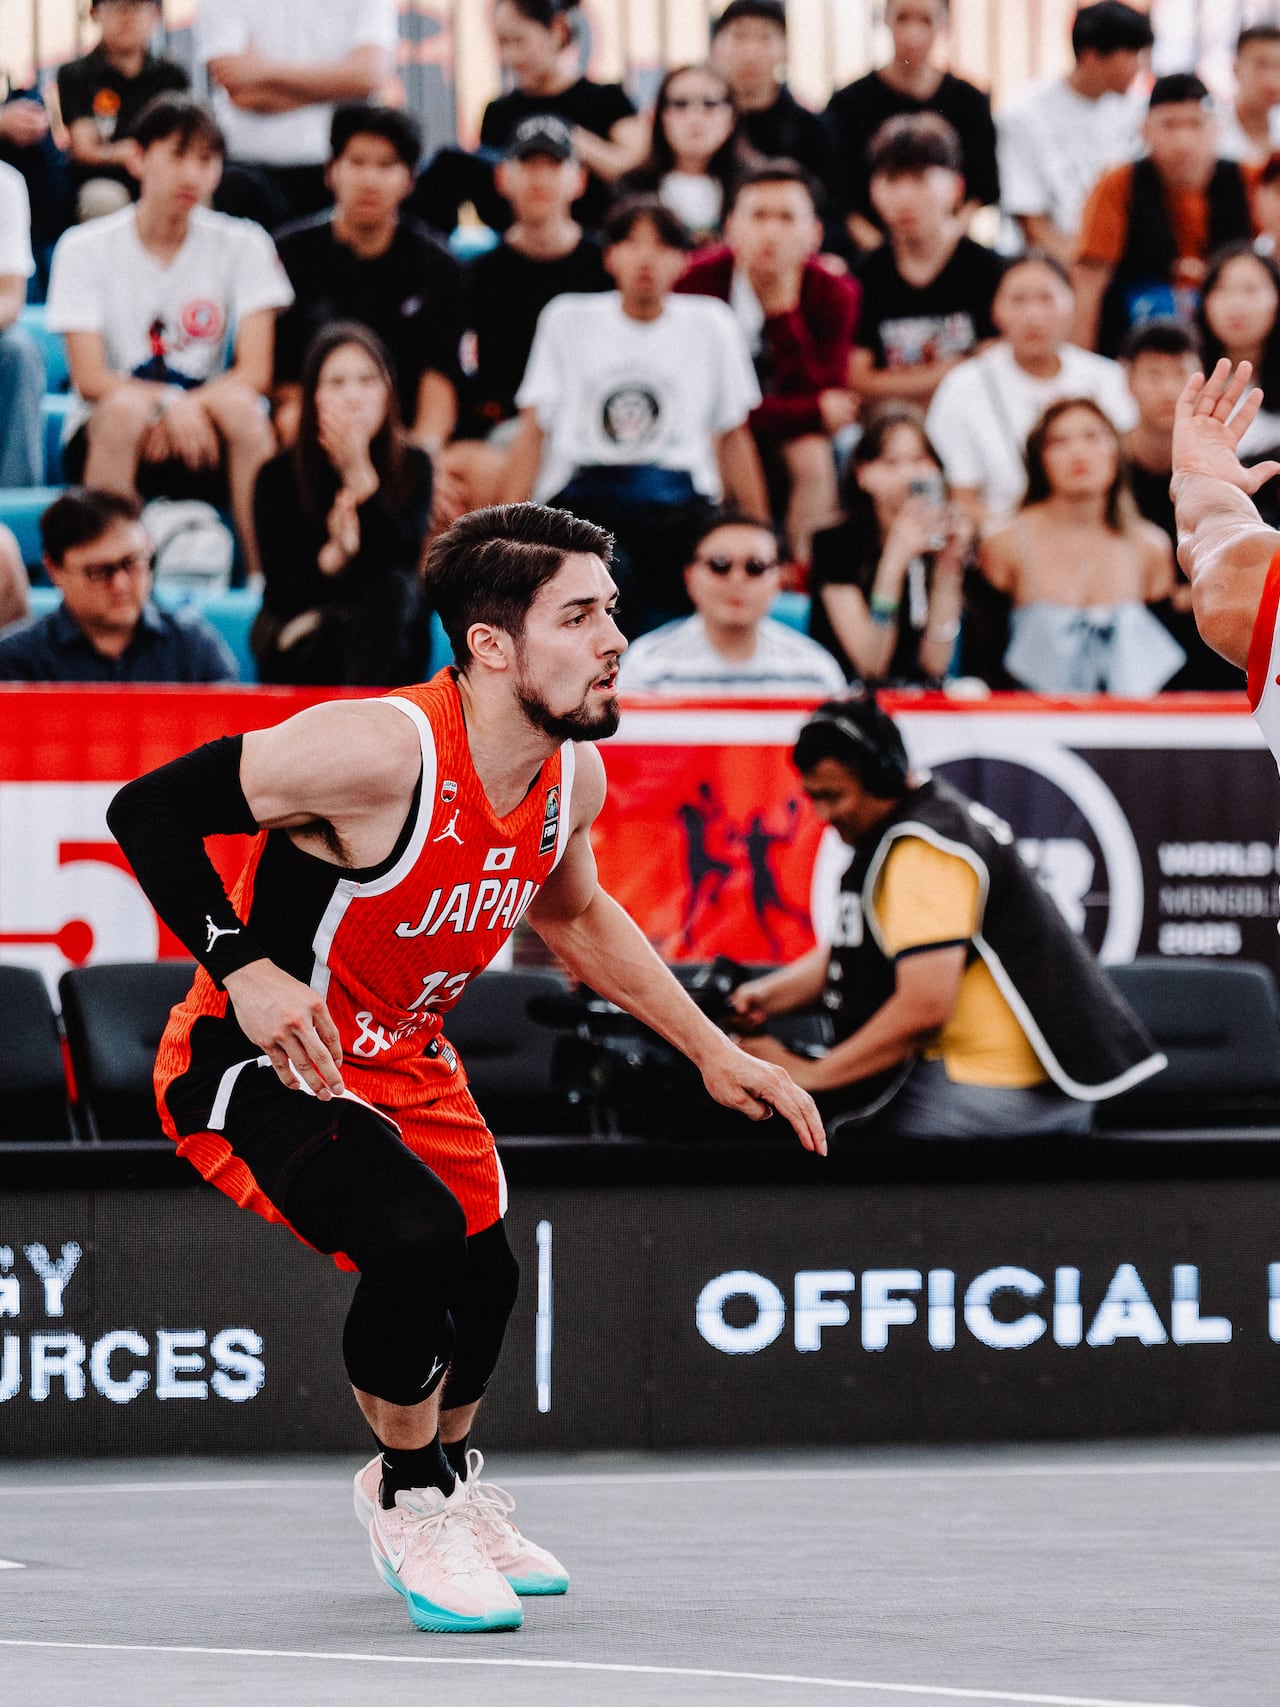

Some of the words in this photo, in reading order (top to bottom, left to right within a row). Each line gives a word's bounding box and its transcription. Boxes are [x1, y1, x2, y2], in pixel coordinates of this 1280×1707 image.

[1158, 841, 1273, 876] WORLD
[394, 877, 541, 938] JAPAN
[1158, 922, 1241, 955] 2025
[695, 1262, 1233, 1356] OFFICIAL
